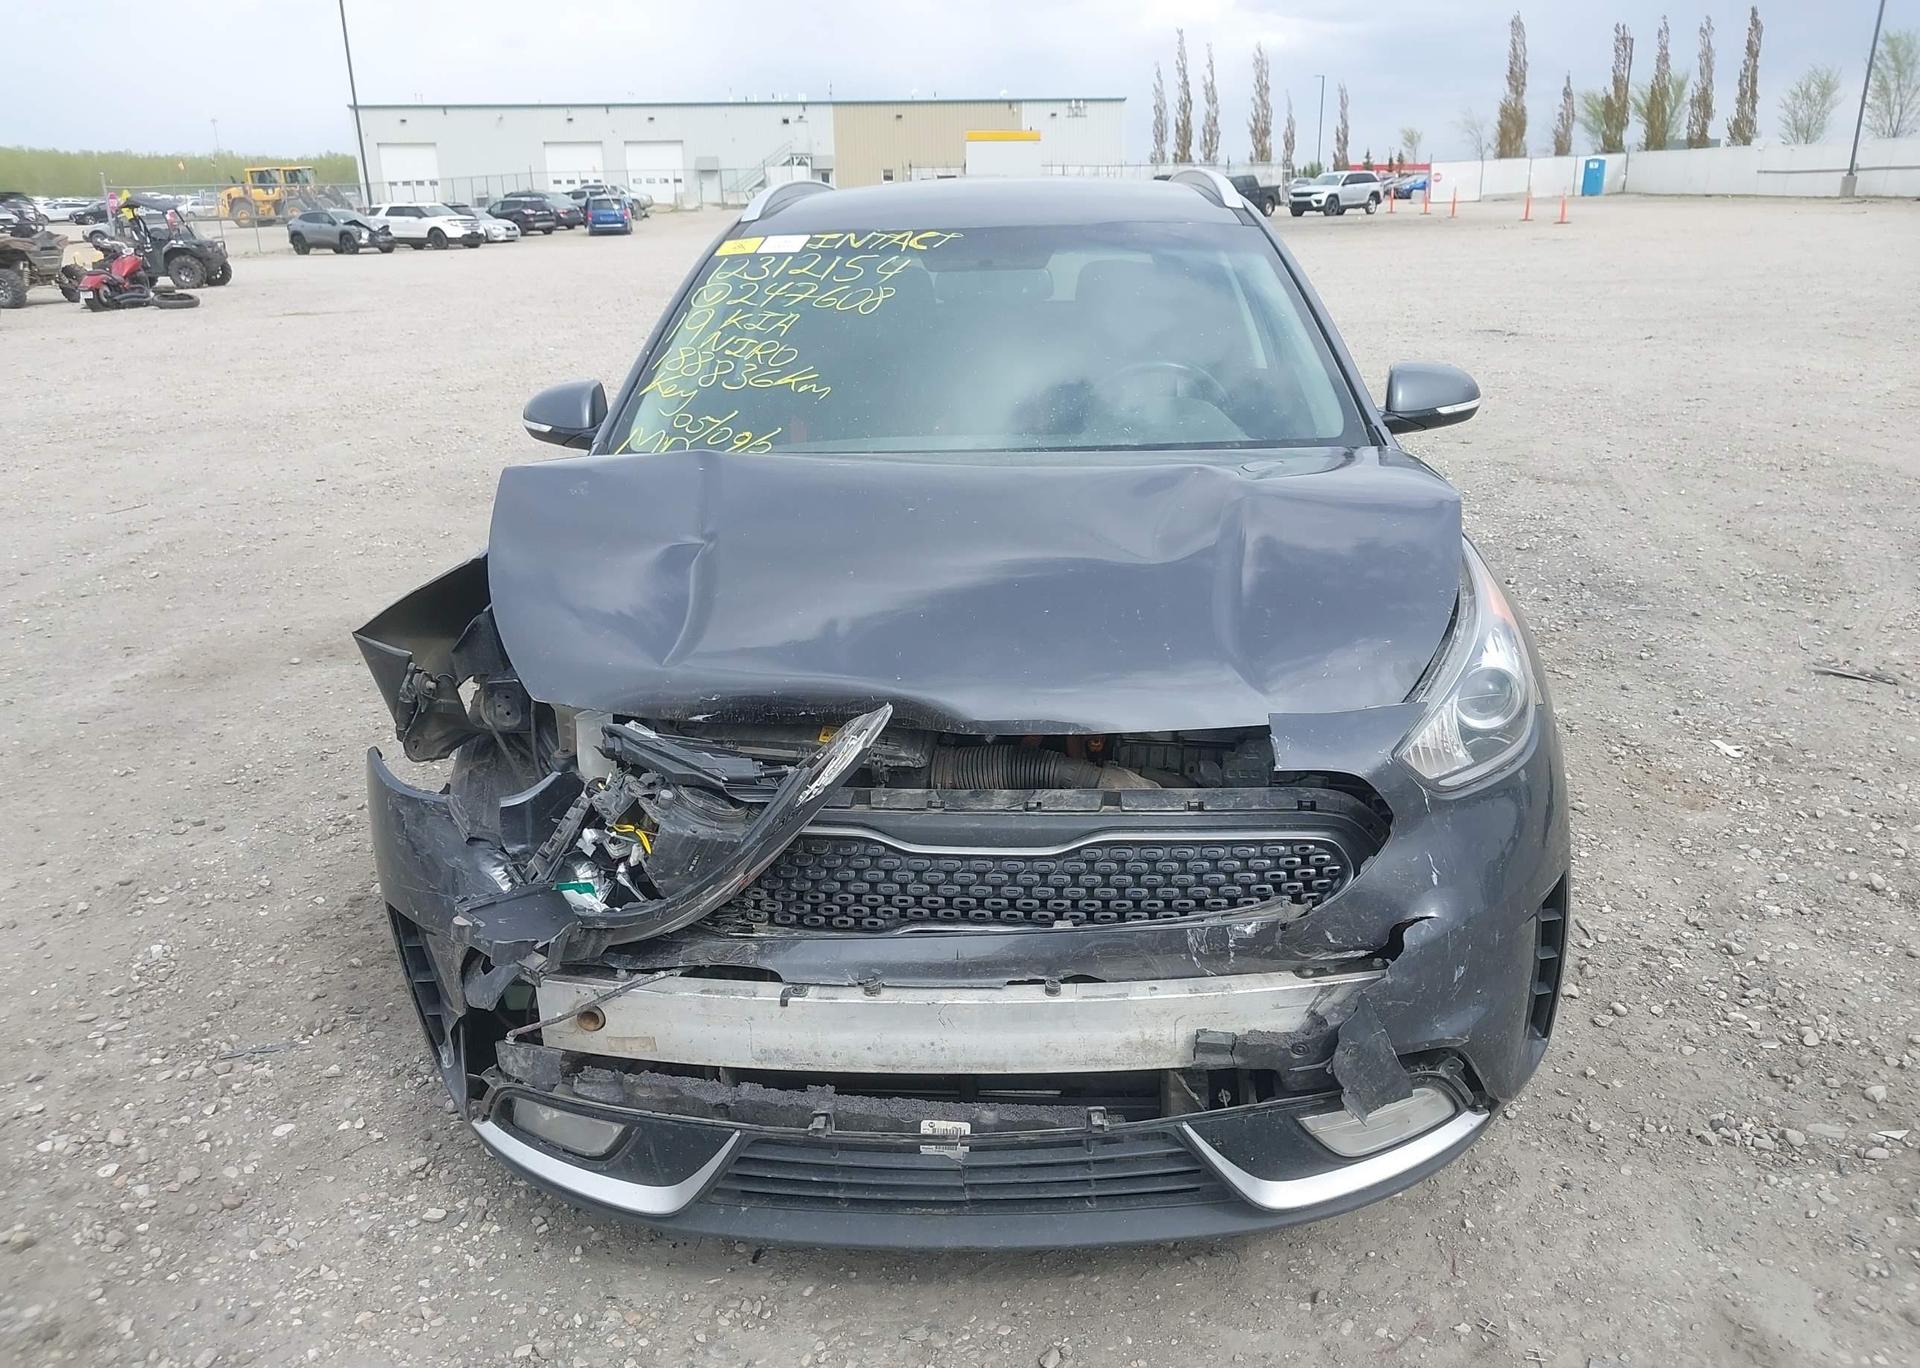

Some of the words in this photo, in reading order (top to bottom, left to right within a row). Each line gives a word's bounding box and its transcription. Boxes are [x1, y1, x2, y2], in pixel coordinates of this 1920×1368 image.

[809, 231, 964, 252] INTACT
[719, 309, 800, 337] KIA
[700, 331, 798, 366] NIRO
